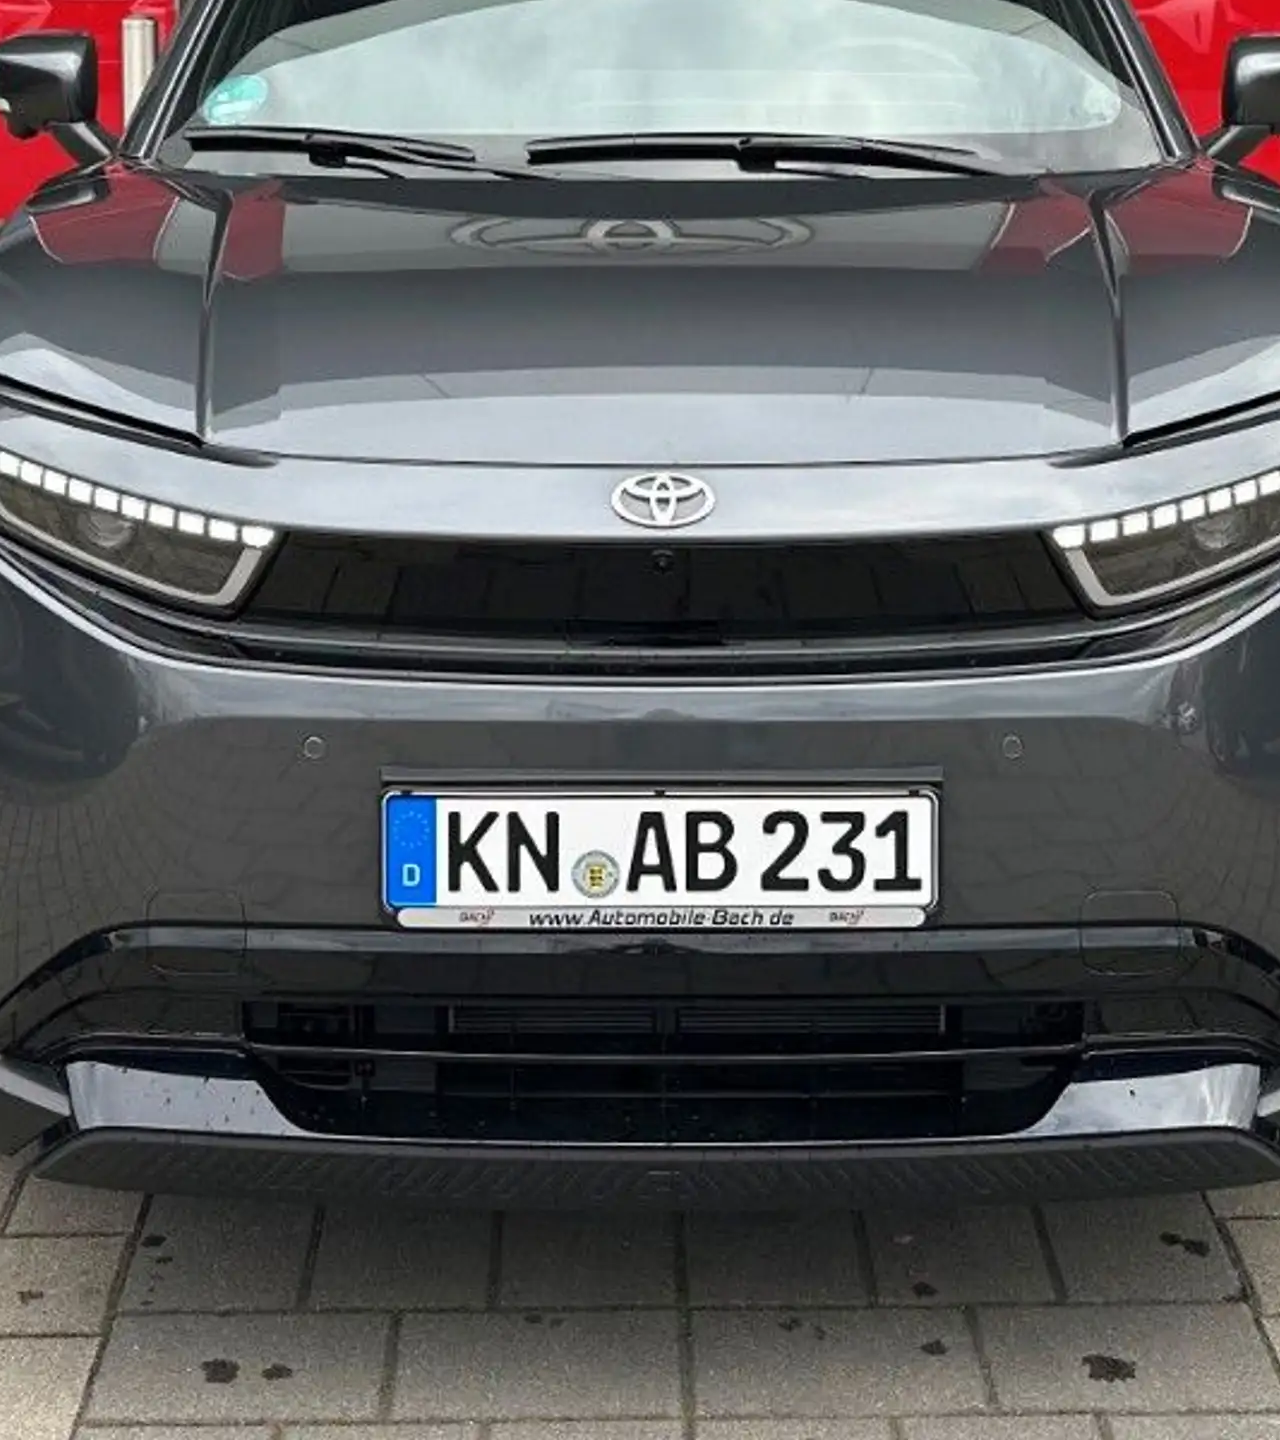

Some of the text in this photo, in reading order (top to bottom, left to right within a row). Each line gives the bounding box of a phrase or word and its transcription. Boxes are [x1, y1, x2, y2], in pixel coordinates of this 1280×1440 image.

[447, 810, 924, 893] KN AB 231
[401, 863, 421, 888] D
[528, 909, 796, 926] www.Automobile-Bach.de
